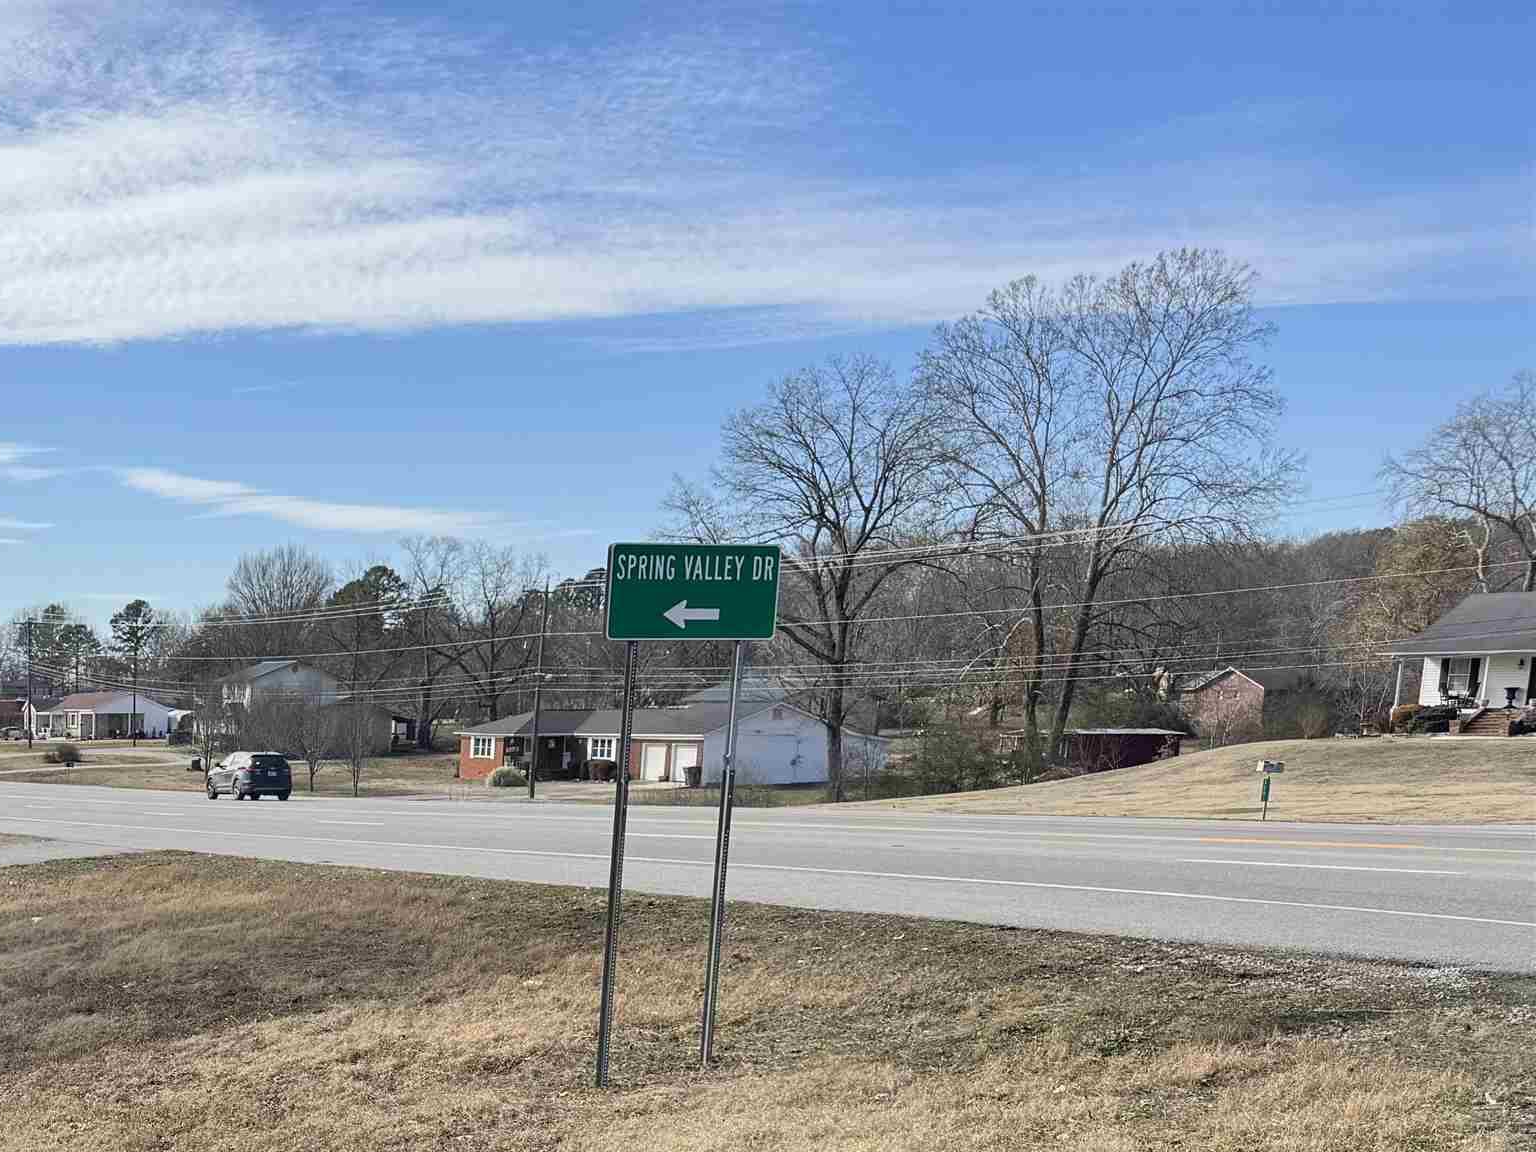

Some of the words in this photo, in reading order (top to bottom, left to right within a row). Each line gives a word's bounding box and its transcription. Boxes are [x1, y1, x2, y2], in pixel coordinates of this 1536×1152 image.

[616, 554, 676, 580] SPRING
[684, 555, 745, 581] VALLEY
[752, 556, 774, 581] DR
